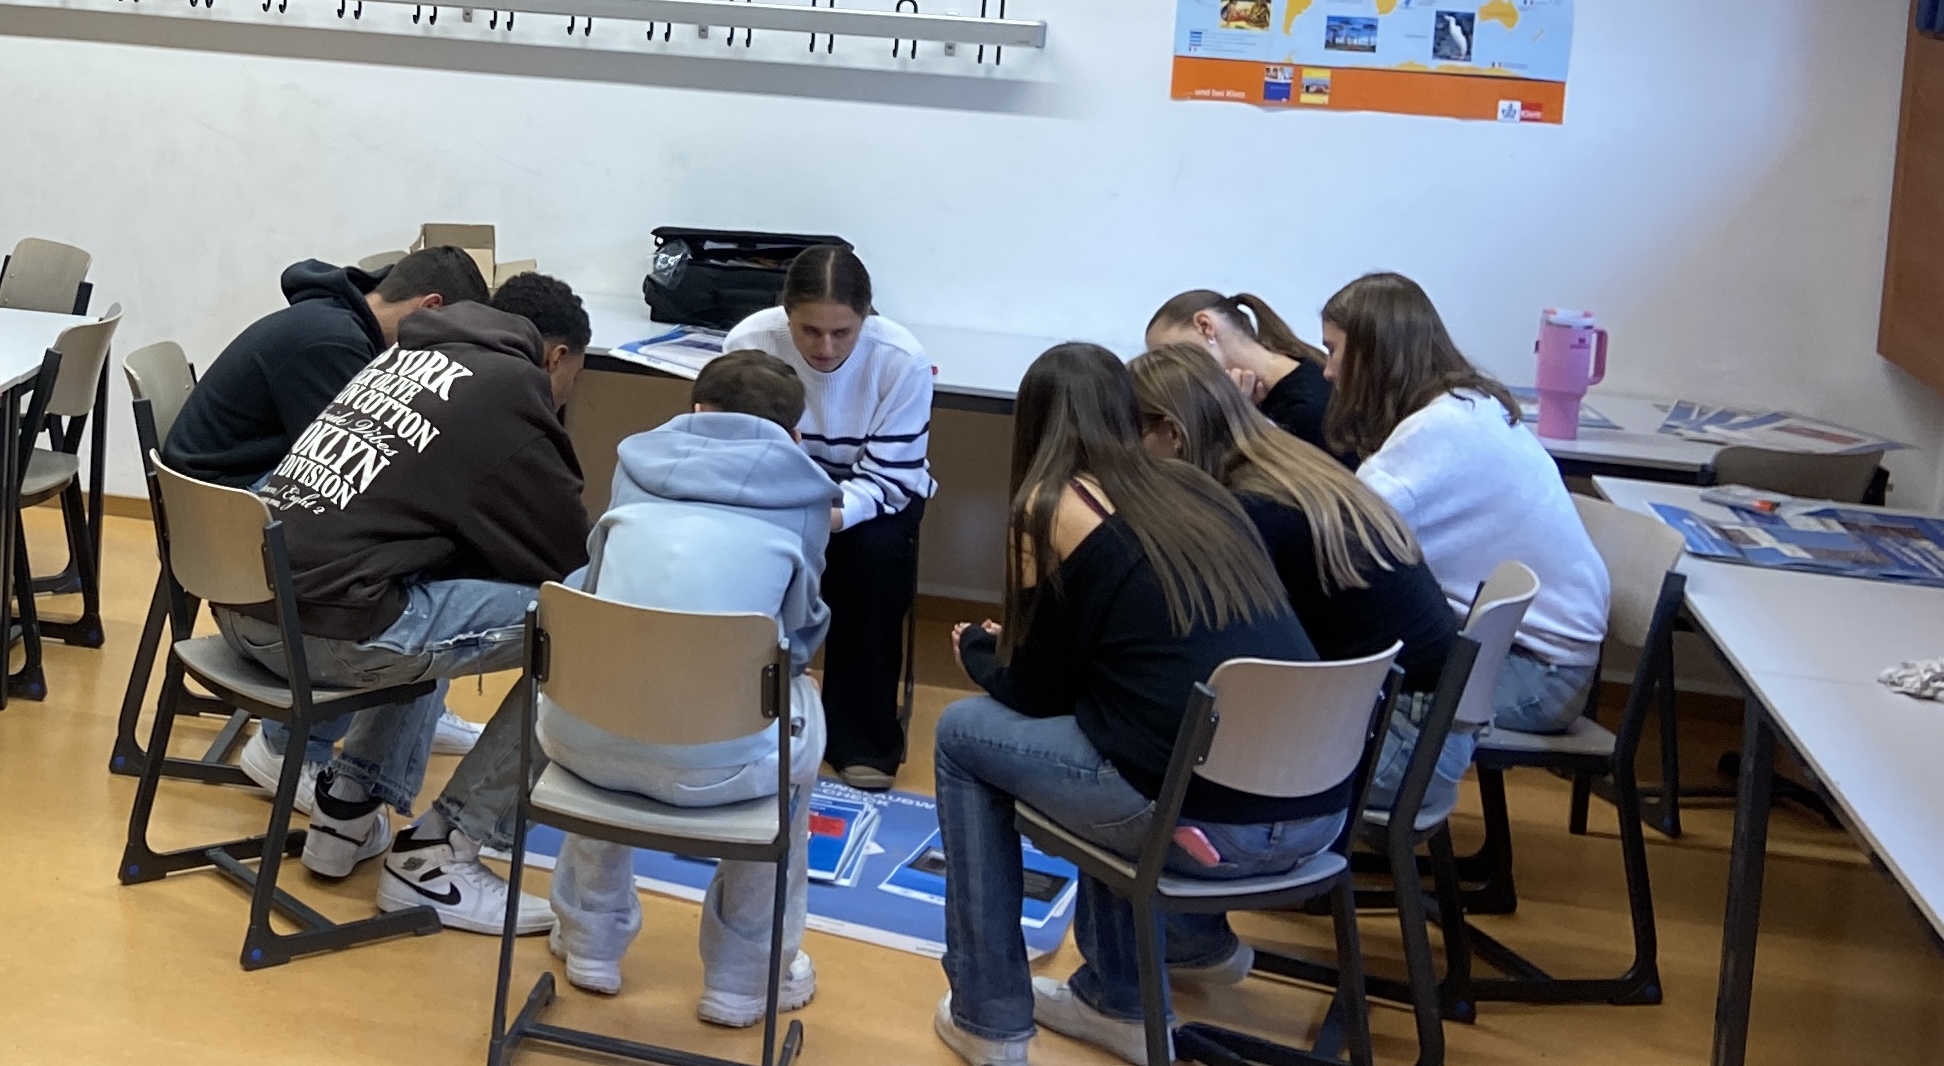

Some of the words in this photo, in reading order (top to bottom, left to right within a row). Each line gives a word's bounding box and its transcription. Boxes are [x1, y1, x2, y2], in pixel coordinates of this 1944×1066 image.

[1226, 88, 1246, 99] Klett
[369, 373, 424, 405] OLIVE
[386, 349, 474, 401] YORK
[347, 419, 400, 457] Vibes
[352, 389, 441, 454] COTTON
[277, 453, 358, 511] DIVISION
[279, 484, 321, 511] Eight
[312, 505, 326, 515] 2
